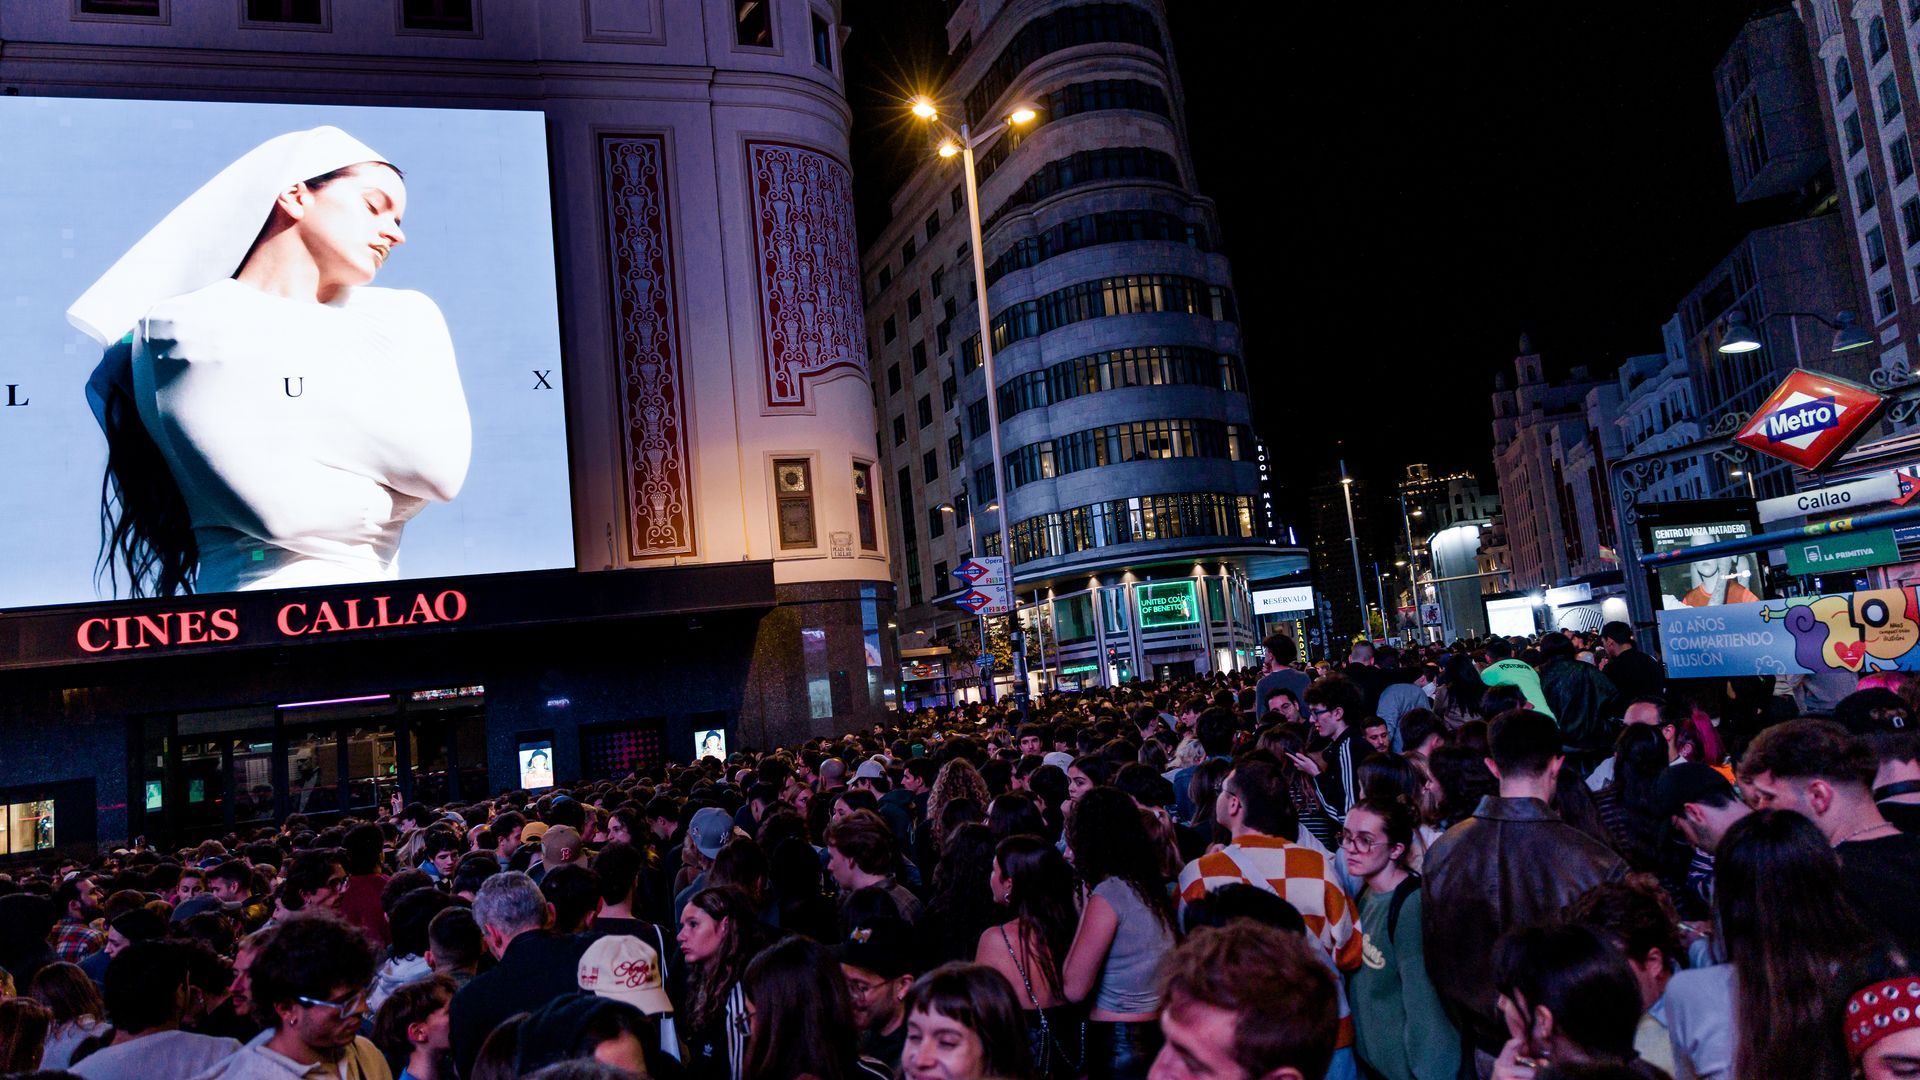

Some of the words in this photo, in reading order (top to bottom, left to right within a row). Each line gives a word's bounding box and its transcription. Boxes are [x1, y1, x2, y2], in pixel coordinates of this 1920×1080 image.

[5, 384, 30, 407] L
[284, 376, 304, 398] U
[532, 369, 553, 390] X
[1770, 407, 1831, 437] Metro
[1257, 445, 1268, 481] ROOM
[1263, 492, 1273, 528] MATE
[1797, 491, 1851, 511] Callao
[1655, 528, 1683, 539] CENTRO
[1684, 526, 1708, 537] DANZA
[1708, 524, 1746, 535] MATADERO
[1835, 547, 1874, 559] PRIMITIVA
[1141, 598, 1167, 607] UNITED
[1263, 595, 1307, 605] RESÉRVALO
[76, 608, 239, 653] CINES
[277, 590, 468, 636] CALLAO
[1668, 621, 1683, 634] 40
[1687, 616, 1725, 633] AÑOS
[1669, 631, 1774, 651] COMPARTIENDO
[1672, 649, 1724, 667] ILUSIÓN
